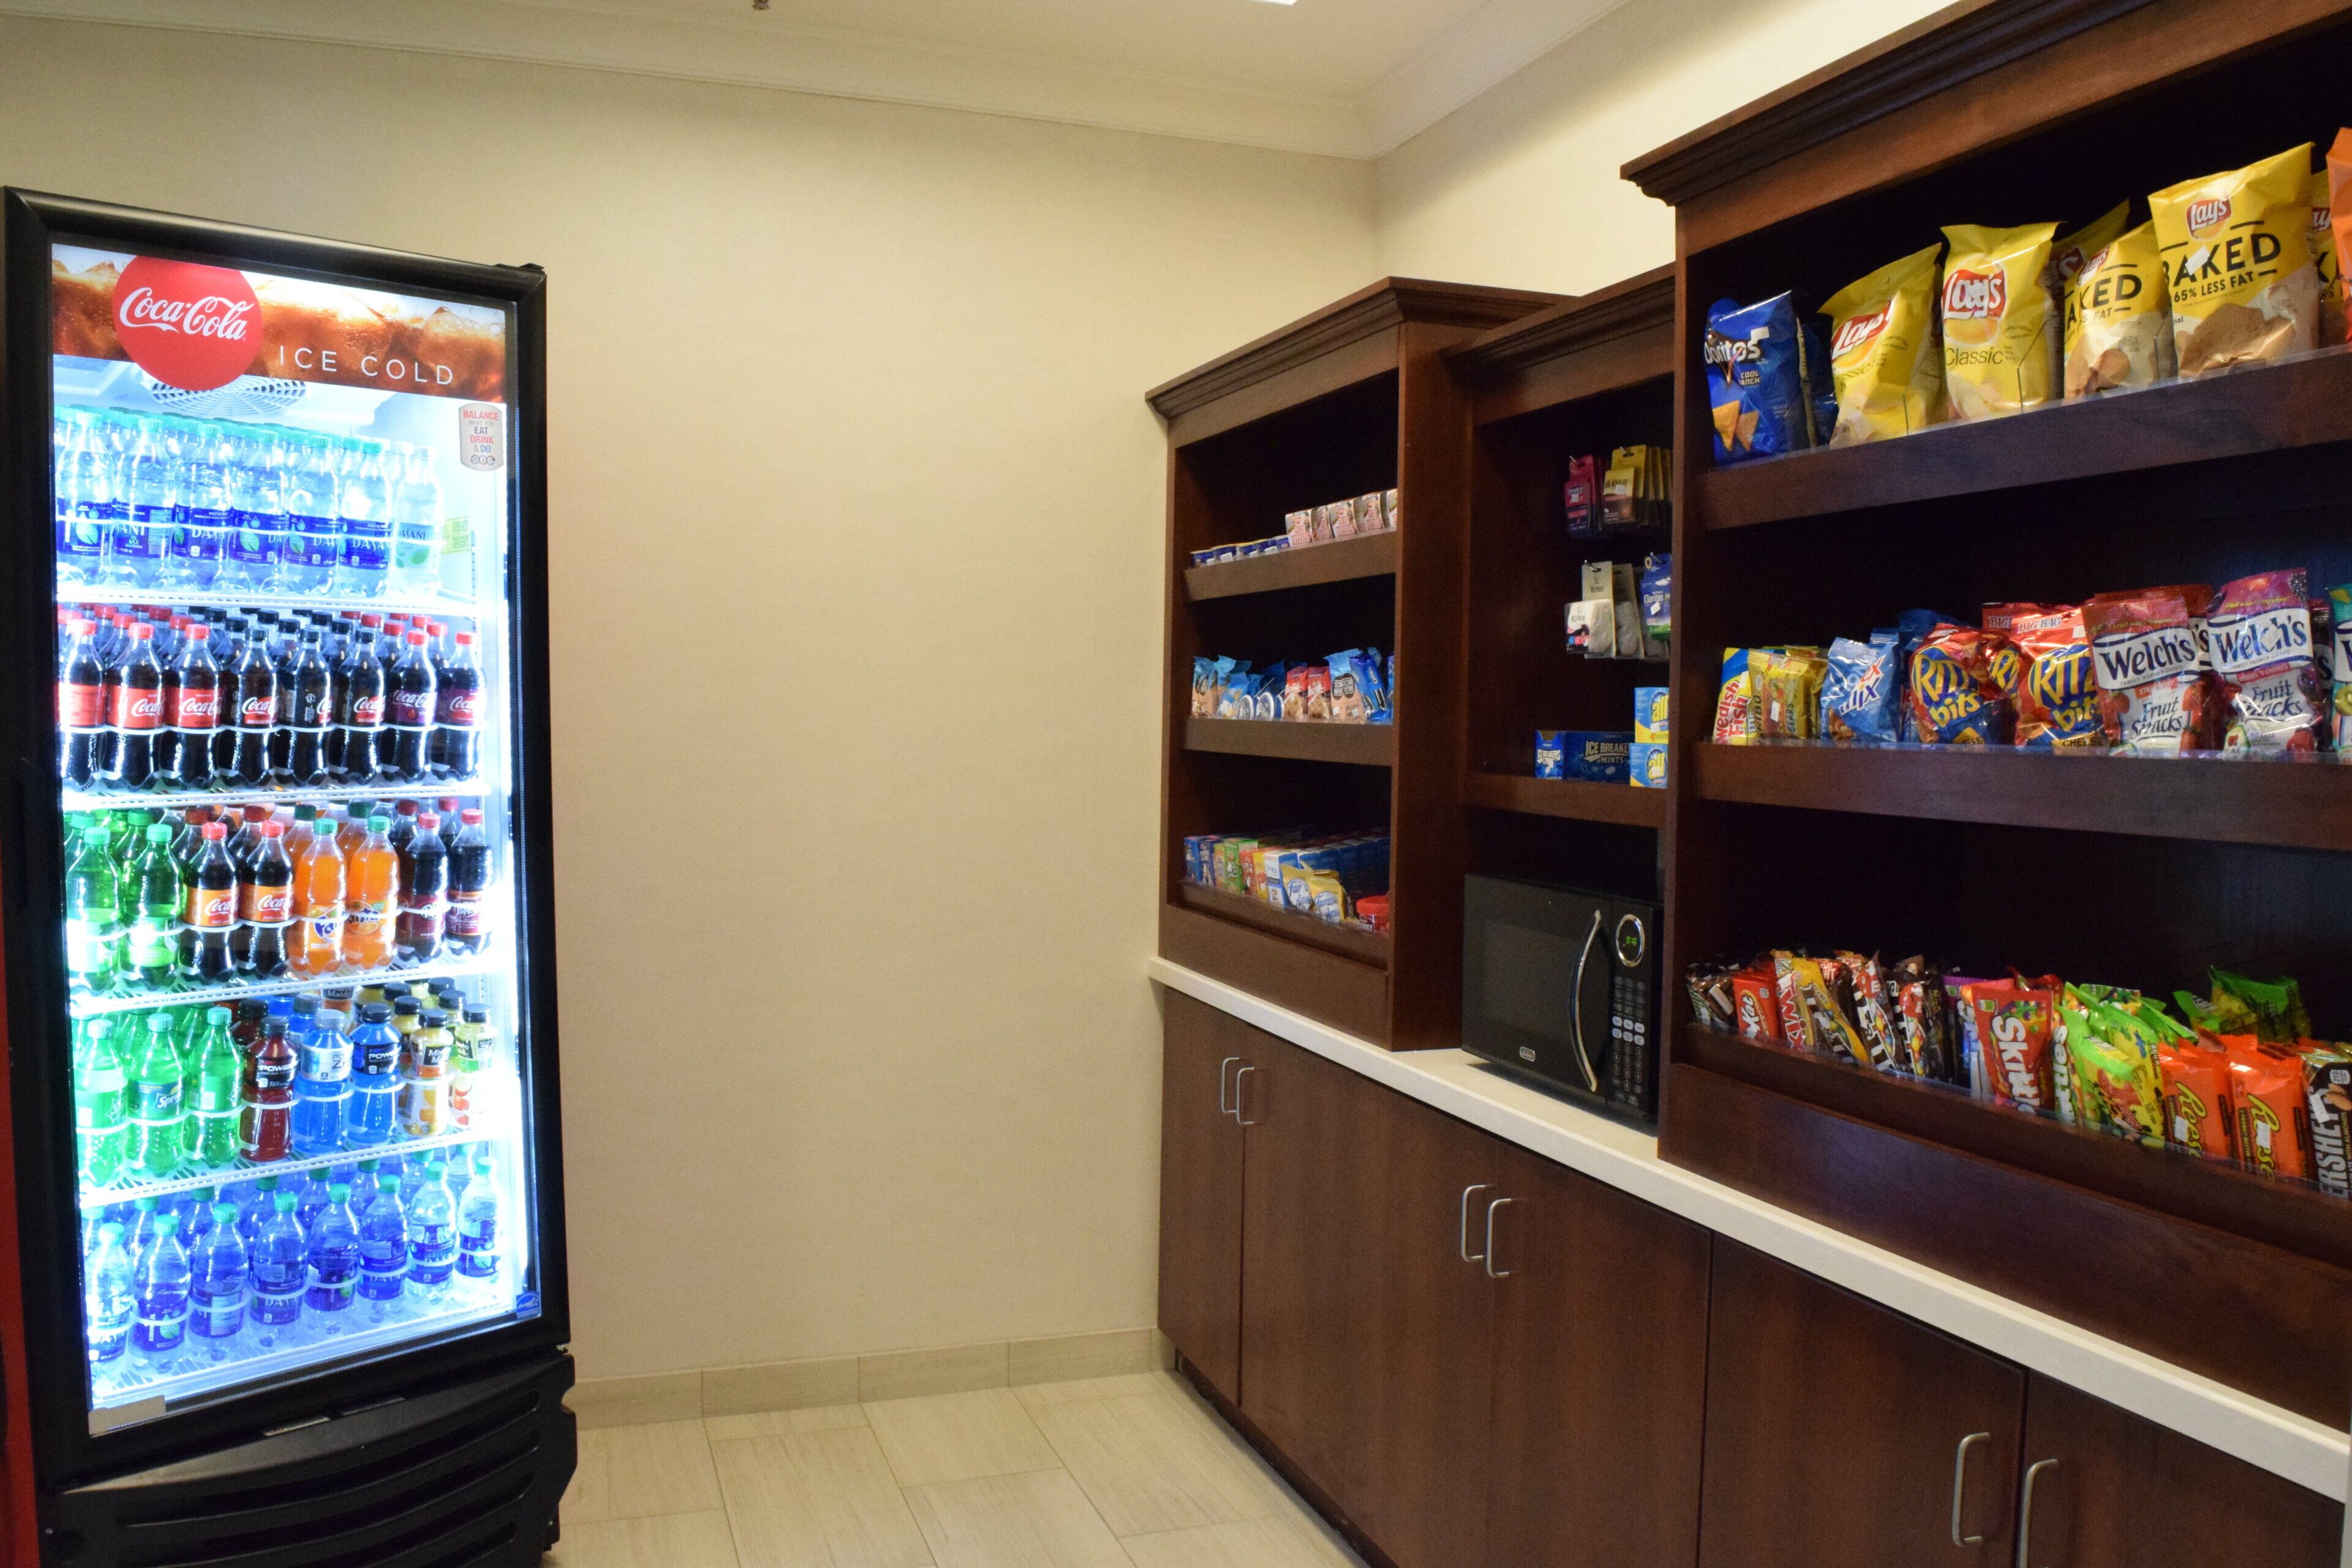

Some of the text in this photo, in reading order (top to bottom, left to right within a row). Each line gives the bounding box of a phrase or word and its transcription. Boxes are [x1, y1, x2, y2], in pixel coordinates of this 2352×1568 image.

[2174, 287, 2198, 303] 65%
[2201, 279, 2226, 296] LESS
[2230, 271, 2254, 288] FAT
[2067, 274, 2143, 331] AKED
[119, 287, 255, 342] Coca-Cola
[1946, 347, 2003, 366] Classic
[279, 345, 454, 386] ICE COLD
[1740, 377, 1760, 386] ANCH
[1741, 370, 1760, 379] COOL
[463, 410, 499, 421] BALANCE
[470, 435, 494, 444] DRINK
[480, 444, 491, 453] DO
[1643, 594, 1664, 604] Claritin
[1571, 614, 1587, 623] Kotex
[1989, 616, 2011, 628] BIG
[2018, 621, 2038, 633] BIG
[2099, 634, 2196, 681] Welch's
[2252, 679, 2294, 703] Fruit
[1728, 695, 1750, 737] Fish
[1929, 692, 1981, 729] bits
[2142, 696, 2180, 722] Fruit
[2130, 713, 2184, 740] Snacks
[1585, 740, 1599, 756] ICE
[1599, 756, 1624, 764] MINTS
[2332, 1071, 2340, 1083] 210
[2341, 1111, 2351, 1144] ALMONDS
